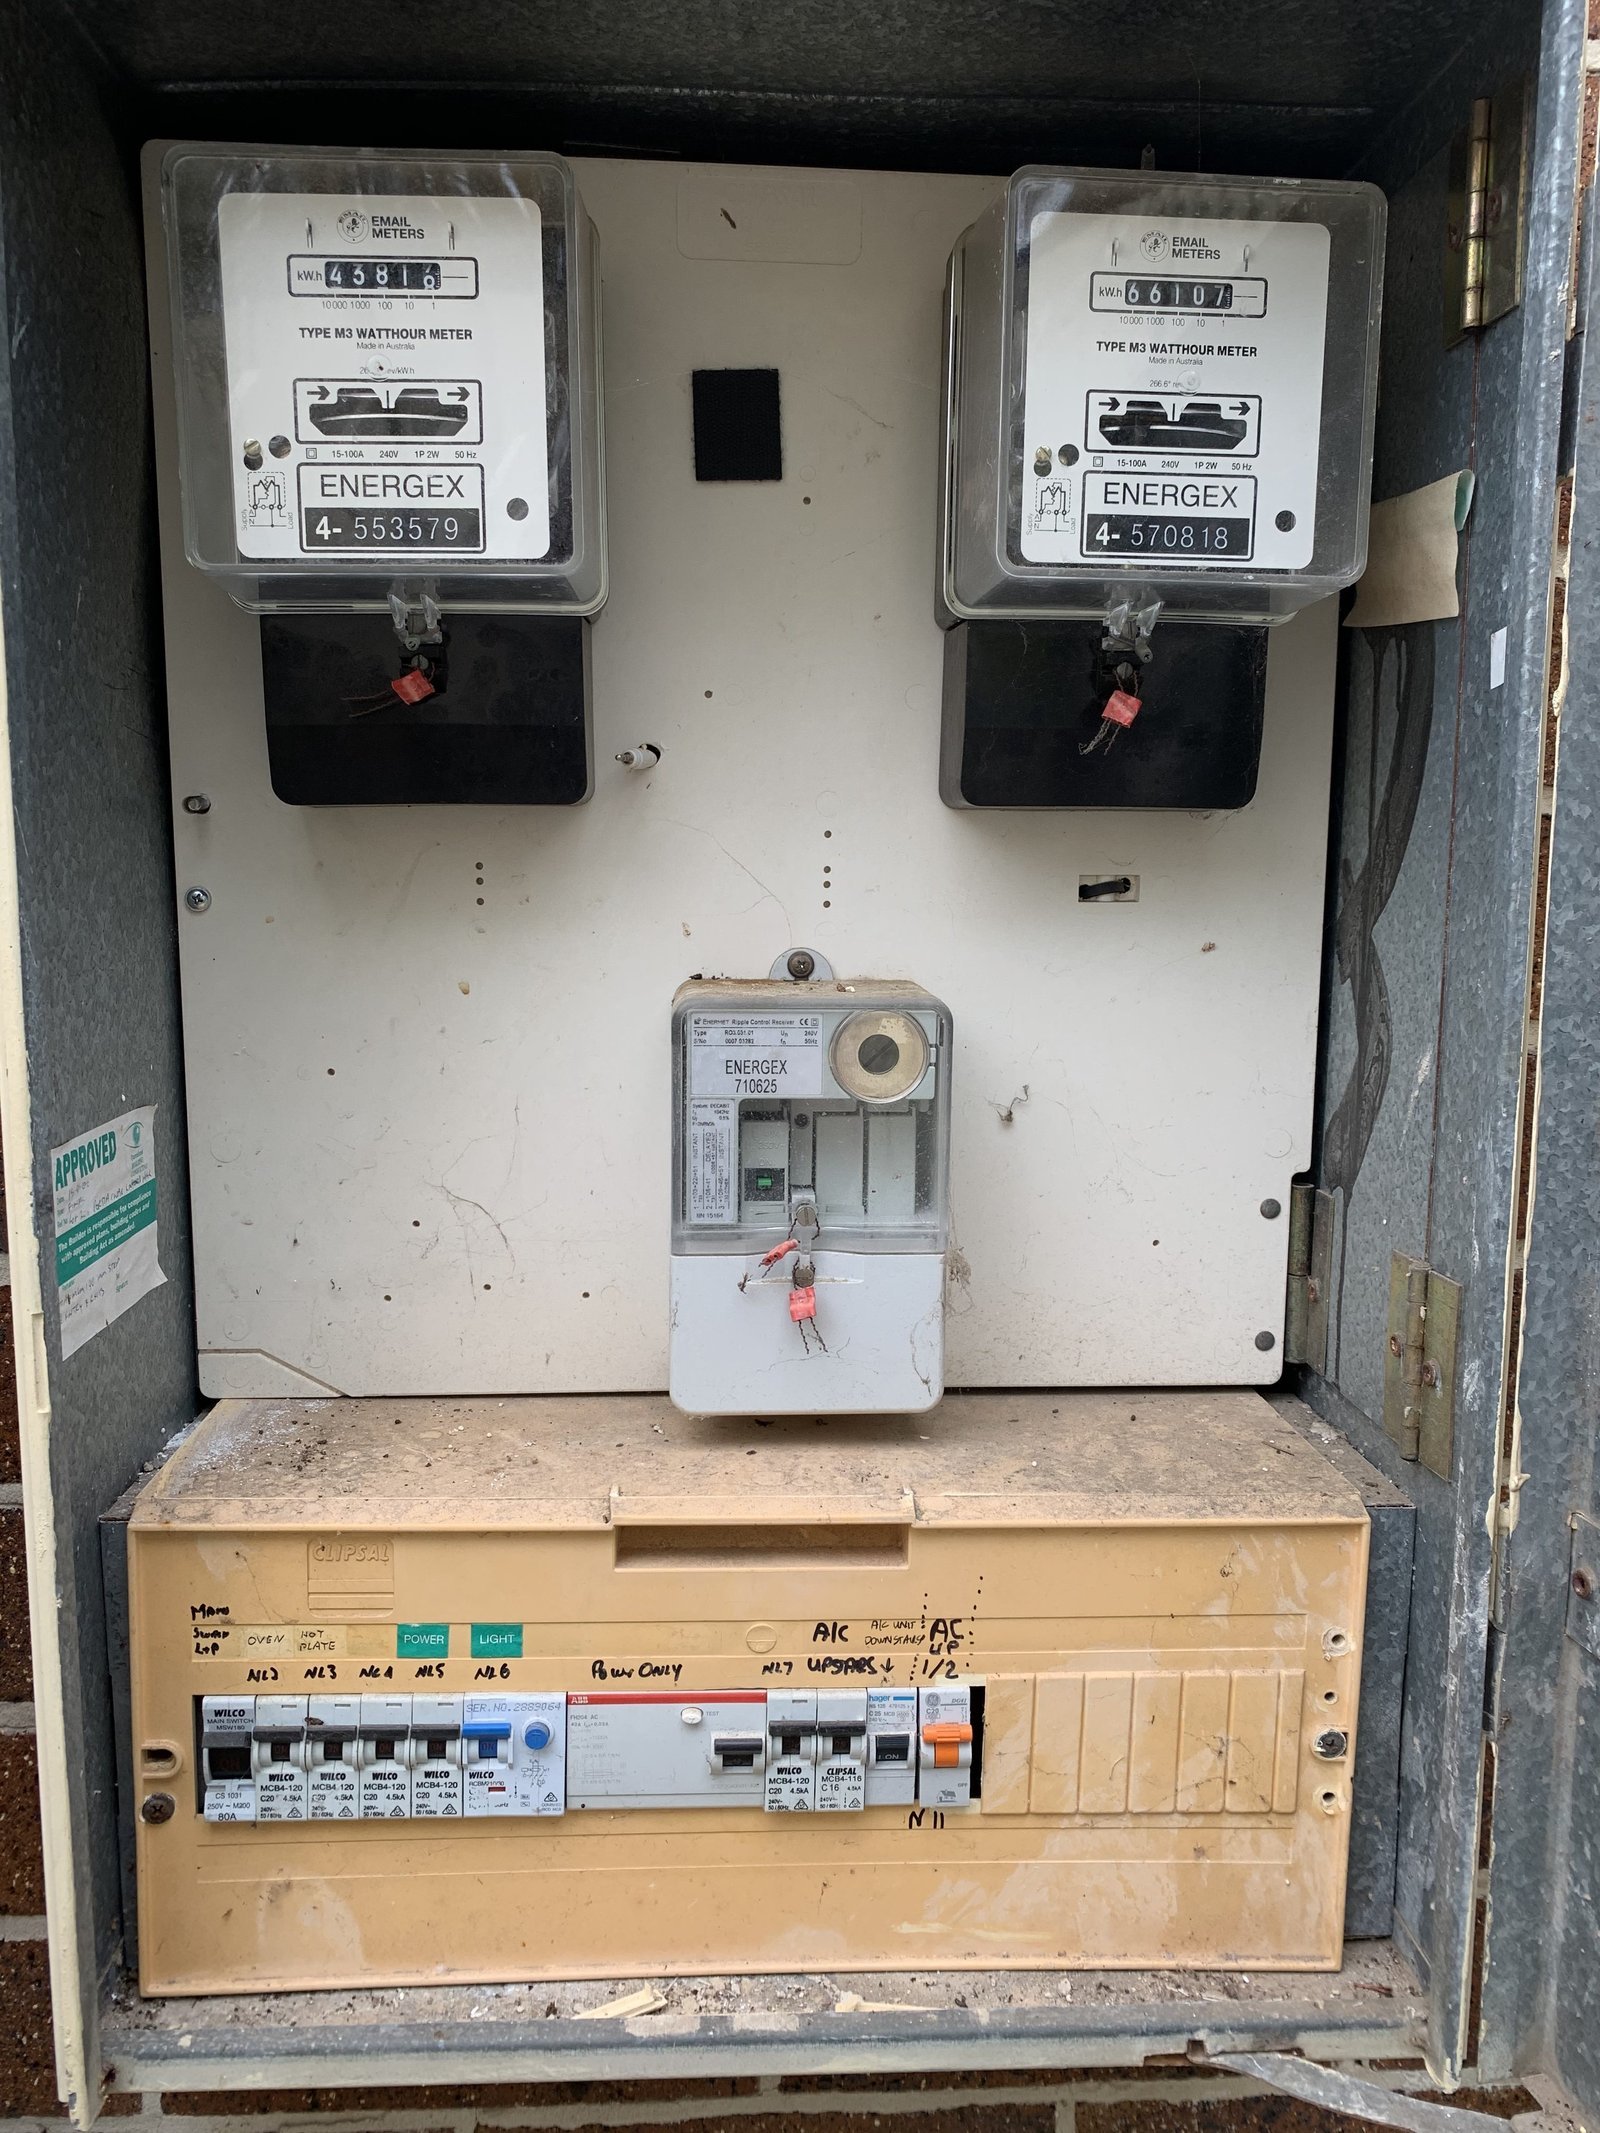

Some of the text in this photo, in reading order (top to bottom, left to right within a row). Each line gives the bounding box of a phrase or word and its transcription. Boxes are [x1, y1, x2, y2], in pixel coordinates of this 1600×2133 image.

[371, 216, 411, 227] EMAIL
[371, 229, 425, 239] METERS
[1172, 237, 1208, 248] EMAIL
[1171, 249, 1221, 260] METERS
[297, 271, 323, 282] kW.h
[1099, 287, 1122, 298] kW.h
[378, 301, 393, 311] 100
[1172, 317, 1185, 327] 100
[299, 327, 473, 341] TYPE M3 WATTHOUR METER
[356, 342, 376, 351] Made
[386, 342, 416, 352] Australia
[1096, 340, 1258, 358] TYPE M3 WATTHOUR METER
[1149, 356, 1167, 365] Made
[1176, 357, 1204, 367] Australia
[332, 450, 364, 459] 15-100A
[380, 450, 399, 459] 240V
[427, 450, 440, 459] 2W
[466, 451, 478, 460] Hz
[1117, 458, 1148, 468] 15-100A
[1161, 460, 1180, 469] 240V
[1205, 462, 1218, 470] 2W
[319, 473, 465, 499] ENERGEX
[1103, 482, 1239, 509] ENERGEX
[354, 516, 460, 541] 553579
[1130, 523, 1229, 550] 570818
[731, 1018, 750, 1026] Ripple
[693, 1029, 707, 1037] Type
[725, 1059, 788, 1075] ENERGEX
[734, 1078, 778, 1094] 710625
[55, 1130, 117, 1192] APPROVED
[58, 1242, 68, 1254] The
[68, 1229, 87, 1247] Builder
[92, 1209, 120, 1232] responsible
[127, 1190, 152, 1209] compliance
[61, 1251, 73, 1264] with
[72, 1236, 96, 1257] approved
[110, 1213, 129, 1232] building
[142, 1200, 151, 1212] and
[79, 1245, 100, 1265] Building
[99, 1237, 109, 1251] Act
[312, 1543, 389, 1562] CLIPSAL
[893, 1620, 917, 1630] UNIT
[929, 1618, 965, 1642] AC
[247, 1634, 285, 1646] OVEN
[403, 1634, 444, 1645] POWER
[479, 1634, 515, 1645] LIGHT
[299, 1640, 336, 1652] PLATE
[929, 1639, 960, 1656] UP
[637, 1661, 683, 1683] ONLY
[571, 1695, 589, 1705] ABB
[868, 1694, 891, 1703] hager
[213, 1708, 246, 1718] WILCO
[885, 1752, 900, 1760] ON
[424, 1770, 450, 1779] WILCO
[468, 1771, 495, 1779] WILCO
[777, 1767, 802, 1775] WILCO
[826, 1767, 857, 1776] CLIPSAL
[268, 1773, 295, 1782] WILCO
[320, 1772, 346, 1781] WILCO
[372, 1772, 398, 1781] WILCO
[768, 1777, 810, 1785] MCB4-120
[821, 1775, 862, 1783] MCB4-116
[260, 1784, 304, 1792] MCB4-120
[363, 1783, 406, 1791] MCB4-120
[415, 1781, 458, 1789] MCB4-120
[227, 1792, 243, 1800] 1031
[438, 1791, 458, 1799] 4.5kA
[768, 1787, 782, 1795] C20
[260, 1794, 303, 1803] C20 4.5kA
[363, 1793, 406, 1801] C20 4.5kA
[206, 1802, 224, 1810] 250V
[217, 1812, 238, 1822] 80A
